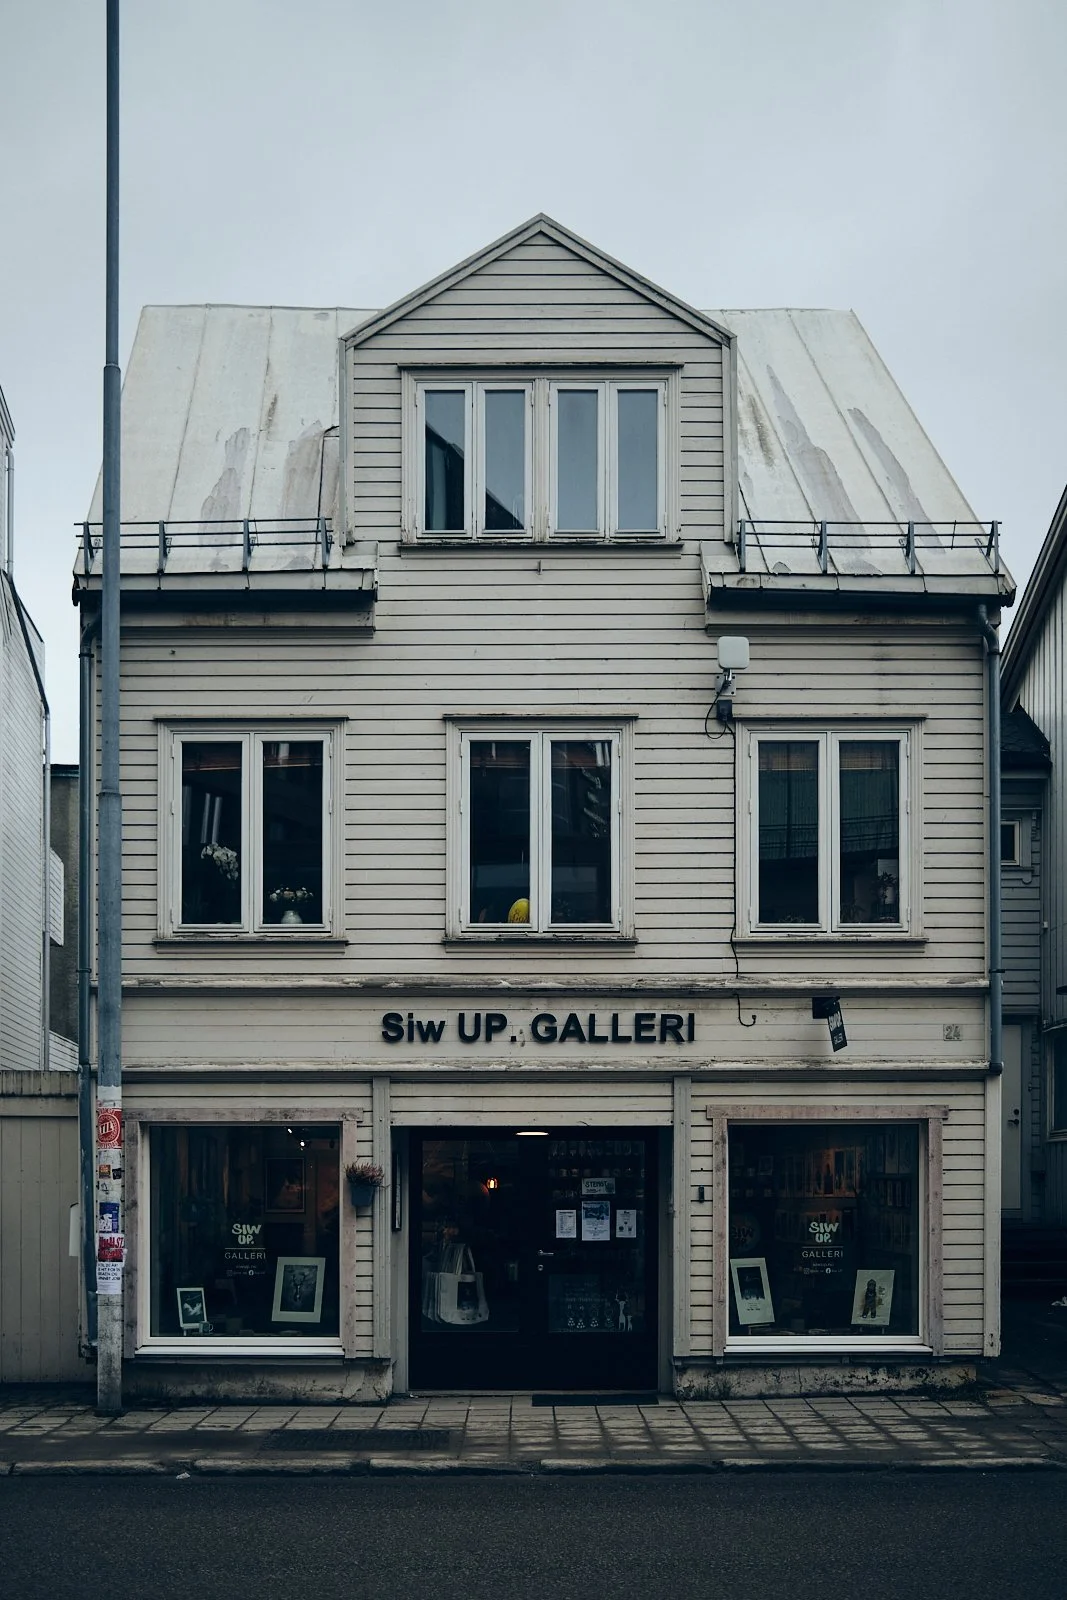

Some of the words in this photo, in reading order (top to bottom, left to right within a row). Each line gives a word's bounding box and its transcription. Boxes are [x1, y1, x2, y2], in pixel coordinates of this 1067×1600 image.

[381, 1012, 446, 1043] Siw
[530, 1012, 696, 1043] GALLERI
[945, 1025, 961, 1040] 24
[231, 1223, 262, 1234] SIW
[808, 1221, 839, 1232] SIW
[801, 1250, 844, 1258] GALLERI
